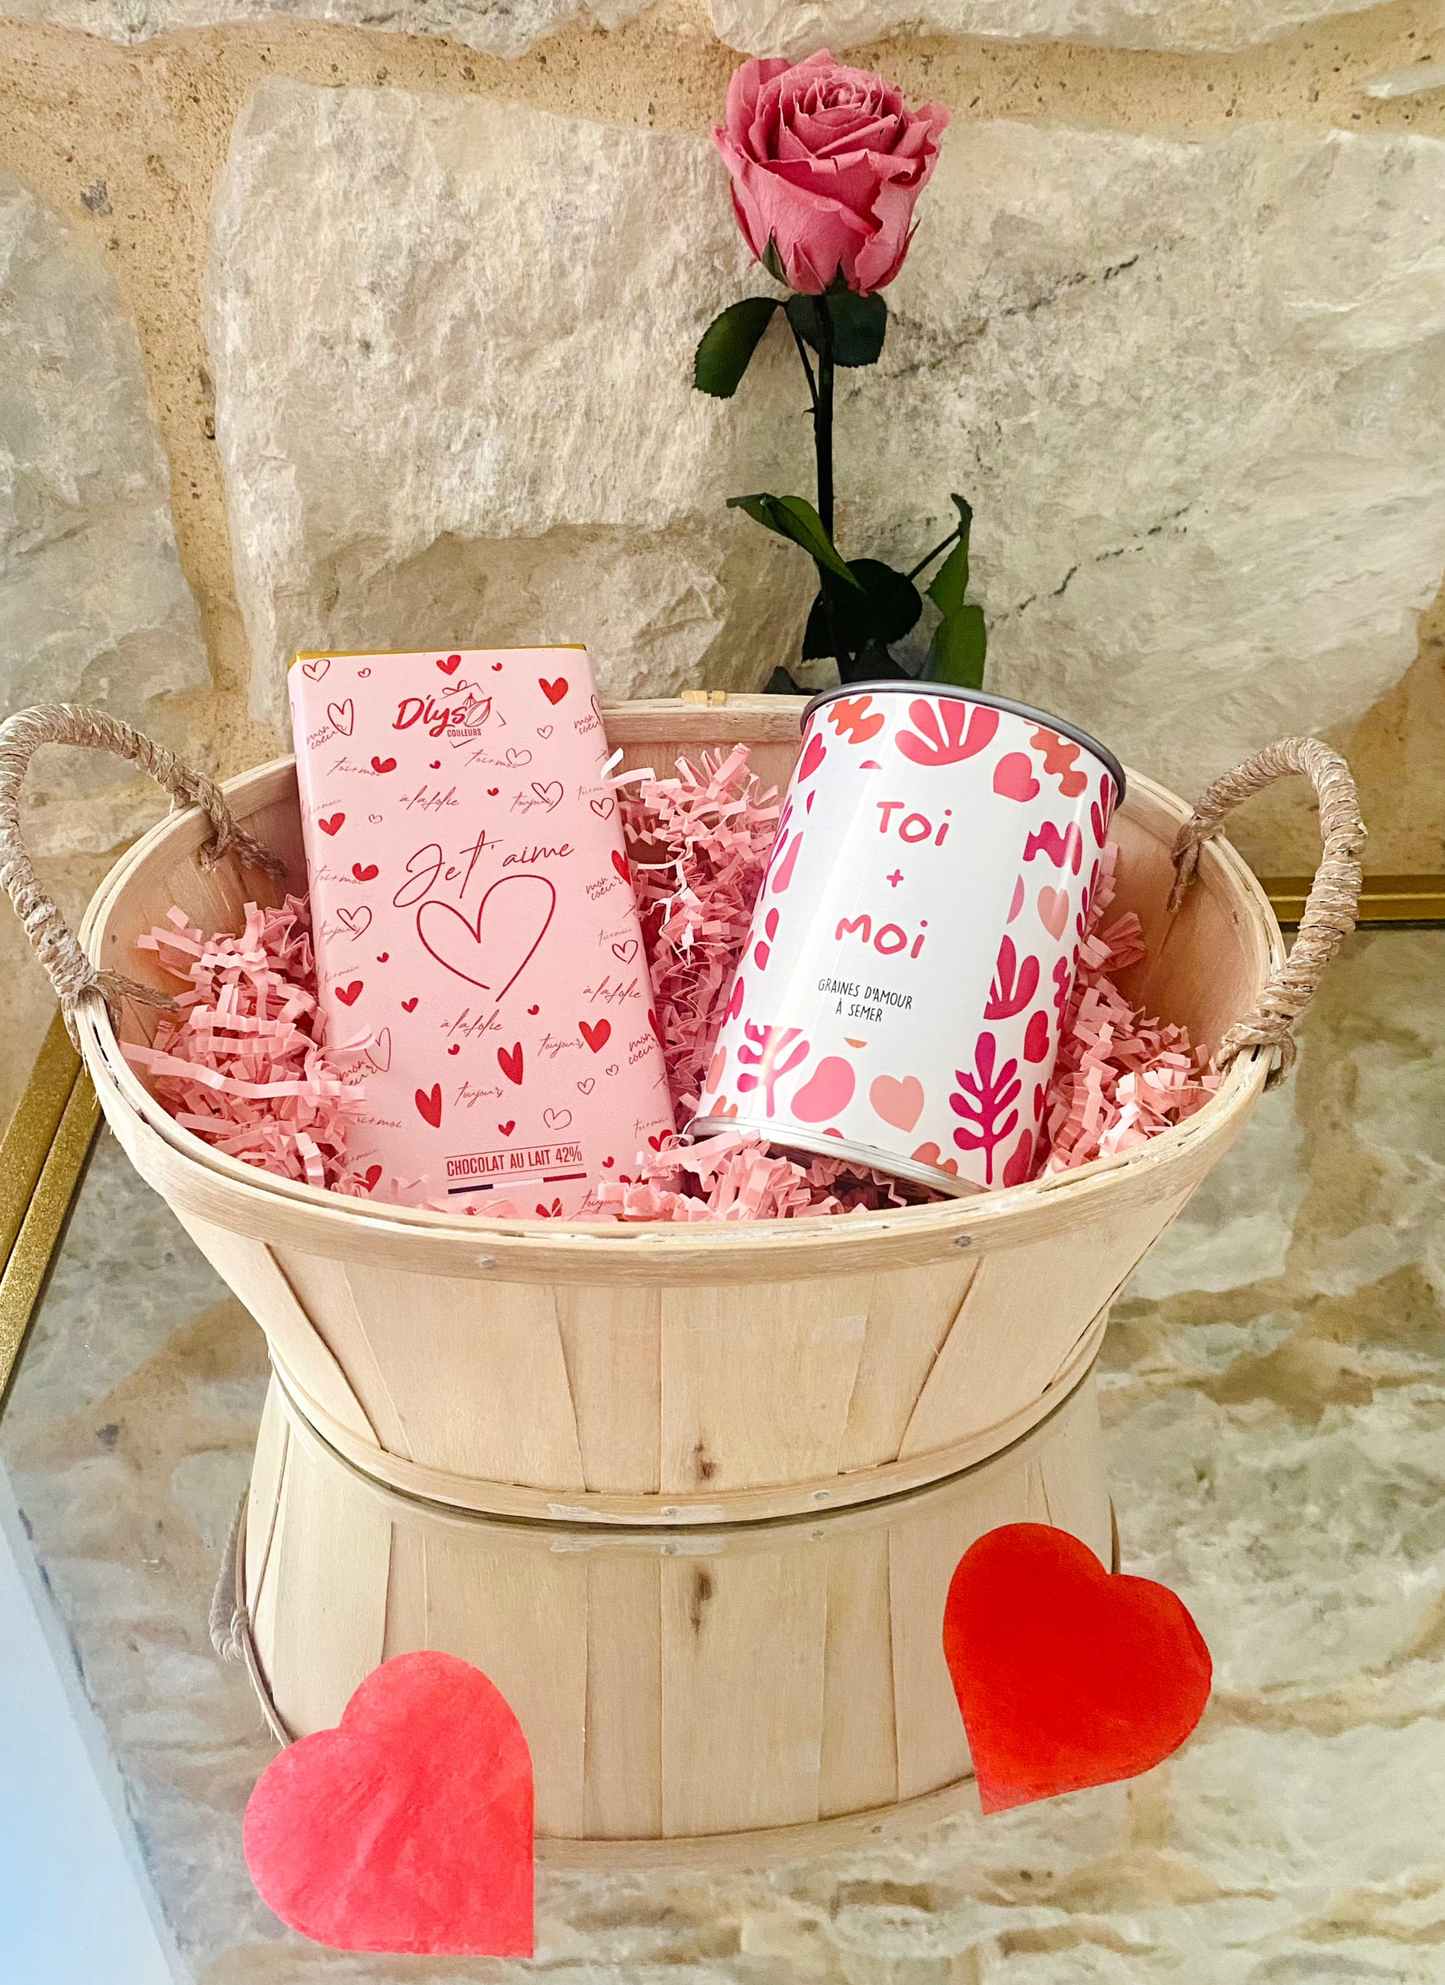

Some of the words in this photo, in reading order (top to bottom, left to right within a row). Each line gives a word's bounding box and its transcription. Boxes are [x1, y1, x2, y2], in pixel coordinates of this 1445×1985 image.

[447, 728, 482, 738] COULEURS
[818, 978, 860, 997] GRAINES
[864, 985, 913, 1010] D'AMOUR
[835, 998, 842, 1015] À
[847, 1004, 883, 1022] SEMER
[446, 1154, 505, 1177] CHOCOLAT
[510, 1152, 524, 1169] AU
[528, 1149, 551, 1167] LAIT
[555, 1145, 582, 1163] 42%
